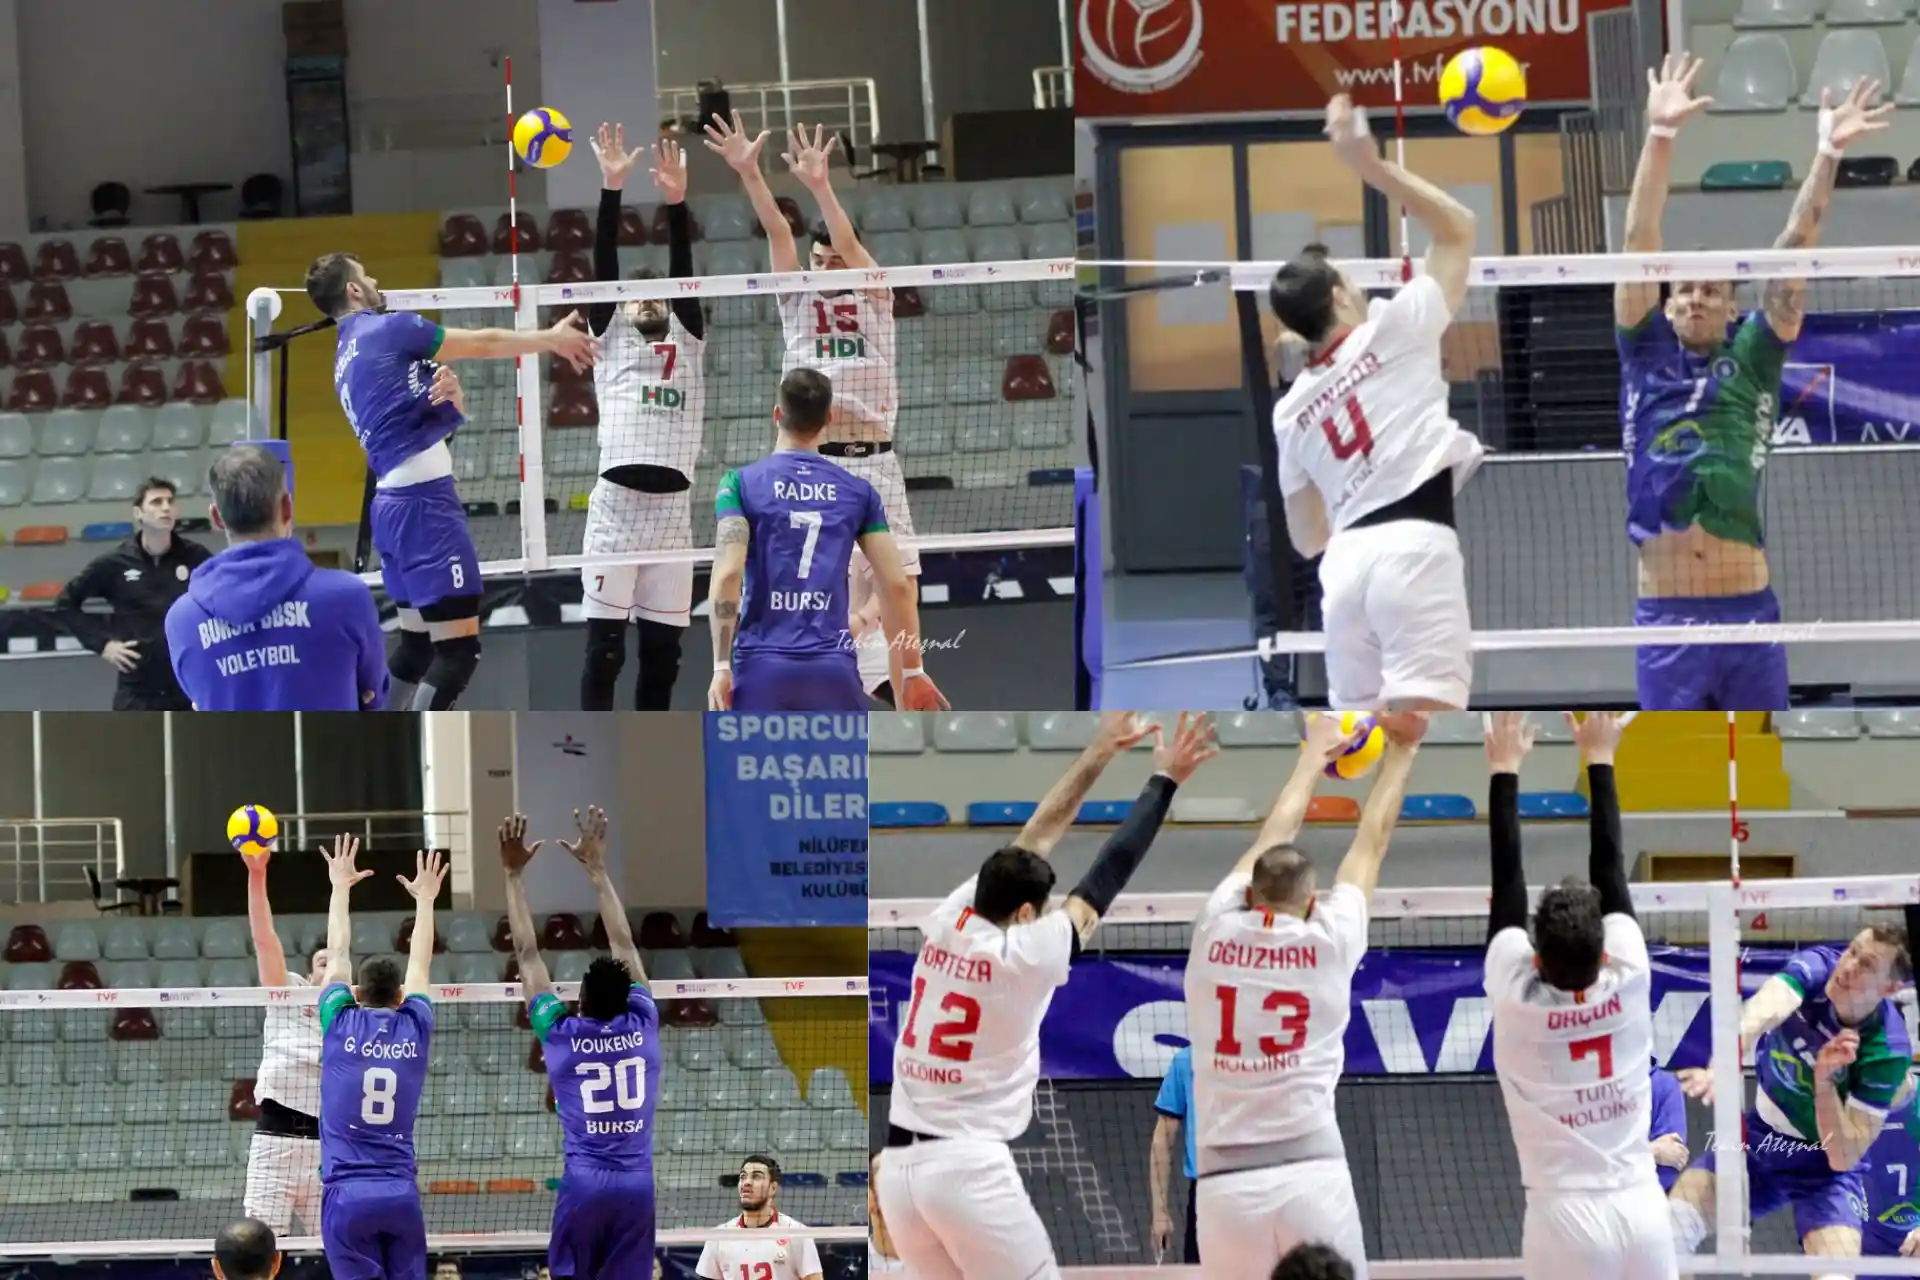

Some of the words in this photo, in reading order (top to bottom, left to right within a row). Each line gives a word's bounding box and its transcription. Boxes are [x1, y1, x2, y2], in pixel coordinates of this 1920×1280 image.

[1276, 0, 1579, 43] FEDERASYONU
[866, 272, 888, 282] TVF
[1049, 262, 1073, 274] TVF
[678, 281, 701, 292] TVF
[812, 300, 859, 334] 15
[815, 338, 865, 358] HDI
[654, 344, 677, 381] 7
[1321, 391, 1375, 461] 4
[774, 481, 837, 501] RADKE
[789, 511, 823, 580] 7
[451, 563, 465, 589] 8
[595, 575, 605, 592] 7
[215, 644, 301, 677] VOLEYBOL
[717, 714, 868, 742] SPORCUL
[737, 754, 868, 792] BAŞARI
[1750, 912, 1769, 931] 4
[1208, 939, 1317, 970] OĞUZHAN
[95, 991, 119, 1003] TVF
[269, 990, 291, 1001] TVF
[440, 987, 464, 998] TVF
[782, 981, 806, 992] TVF
[902, 975, 982, 1062] 12
[1214, 984, 1310, 1056] 13
[344, 1036, 357, 1054] G.
[361, 1037, 419, 1060] GÖKGÖZ
[570, 1031, 644, 1054] VOUKENG
[1568, 1033, 1614, 1079] 7
[899, 1056, 963, 1084] OLDING
[361, 1066, 397, 1125] 8
[574, 1056, 647, 1114] 20
[1886, 1163, 1908, 1196] 7
